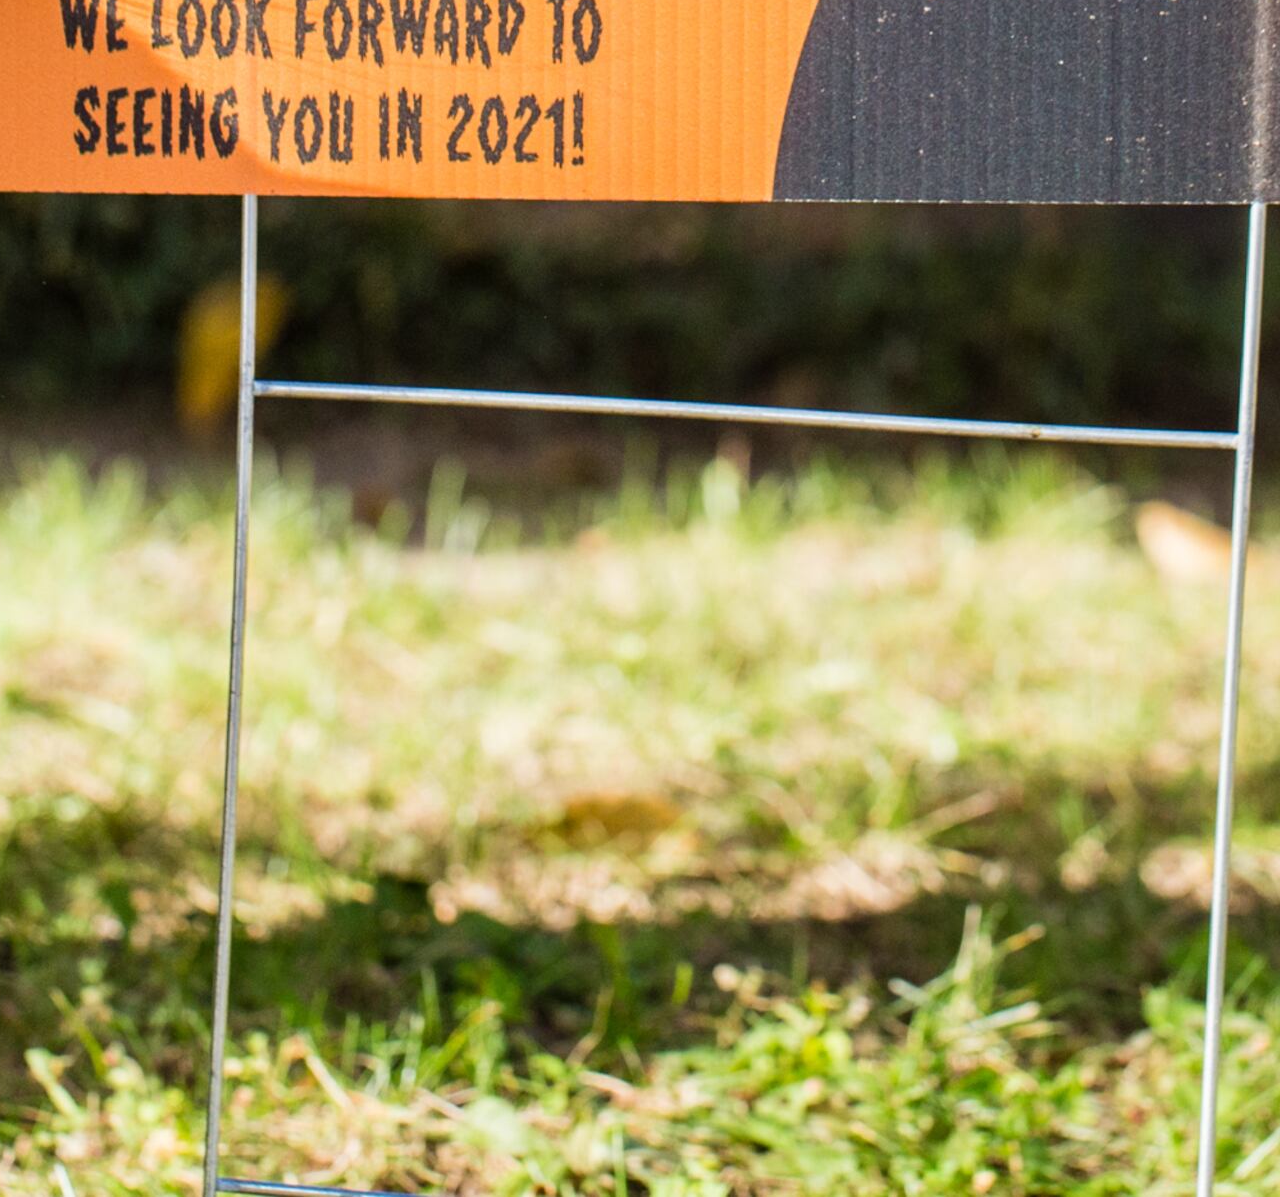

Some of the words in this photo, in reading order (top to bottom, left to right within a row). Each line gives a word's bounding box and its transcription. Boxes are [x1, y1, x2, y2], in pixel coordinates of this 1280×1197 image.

[74, 85, 237, 159] SEEING
[264, 94, 352, 163] YOU
[380, 90, 421, 162] IN
[448, 94, 582, 167] 2021!
